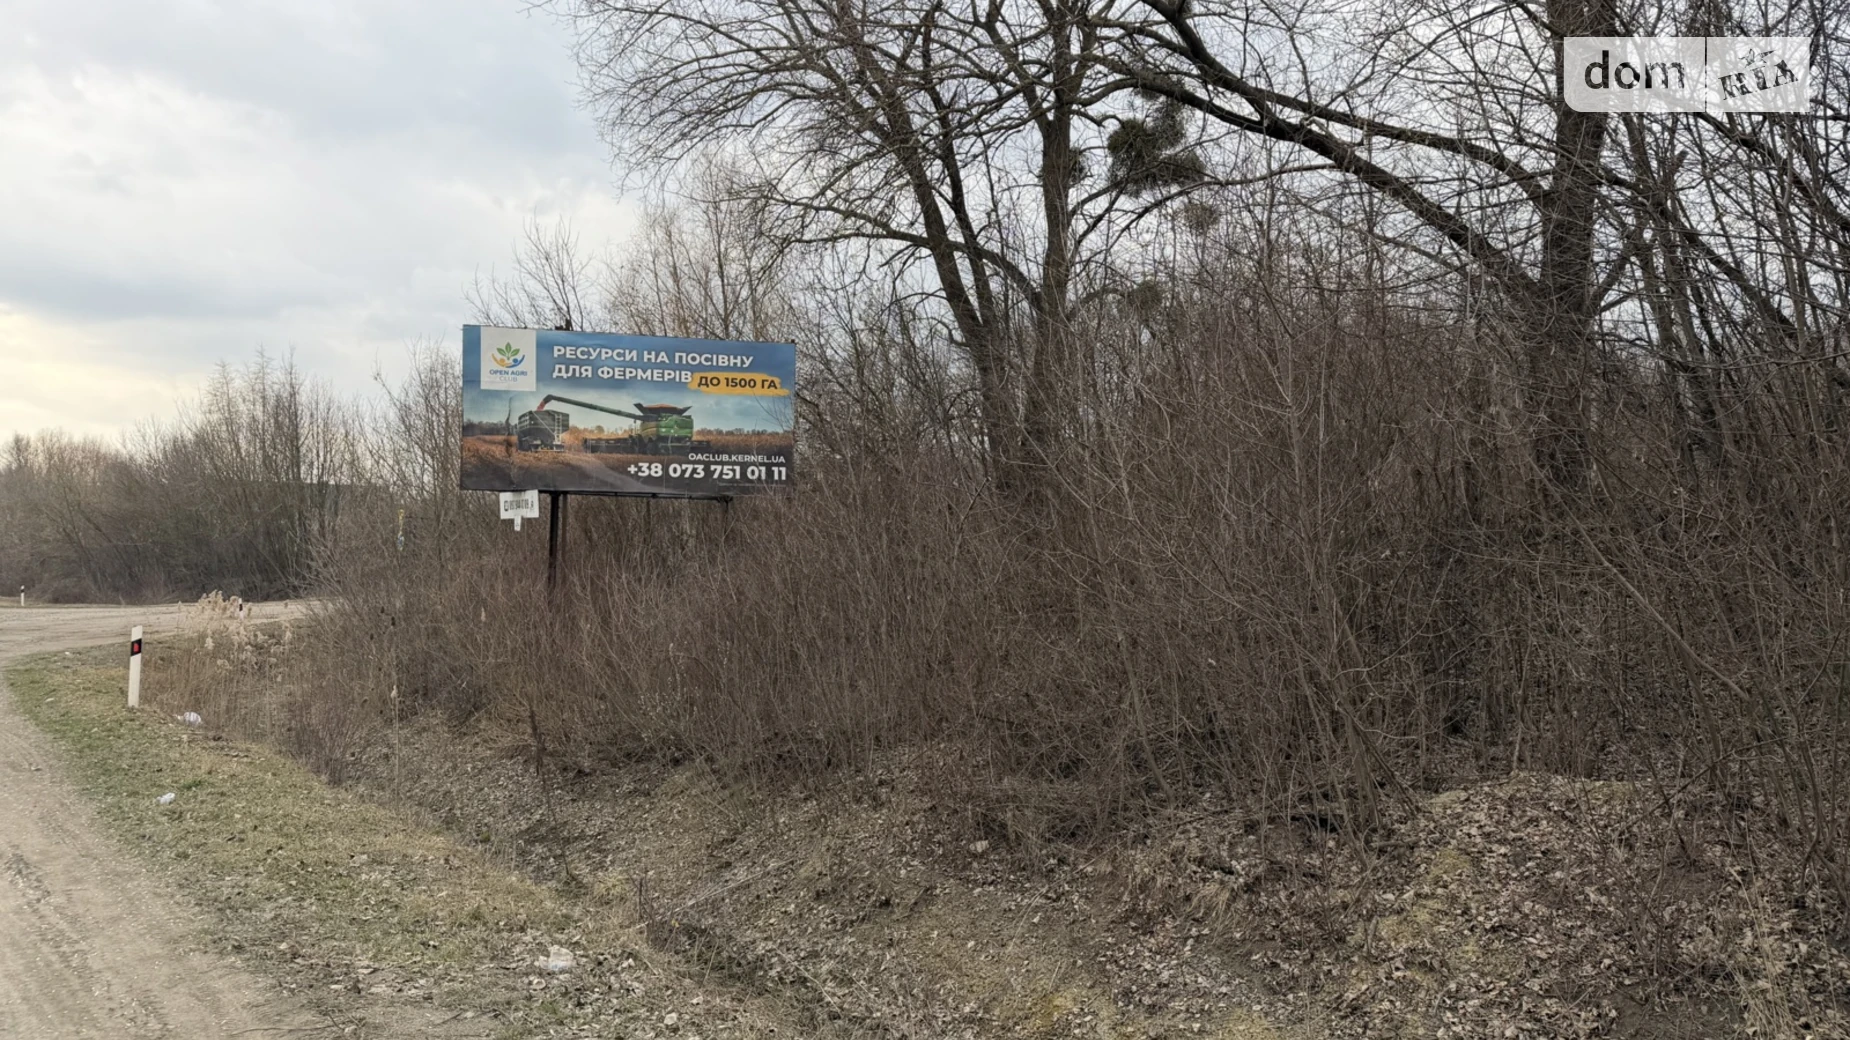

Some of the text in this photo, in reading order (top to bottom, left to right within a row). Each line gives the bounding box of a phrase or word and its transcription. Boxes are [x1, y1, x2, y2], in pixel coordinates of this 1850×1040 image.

[553, 345, 754, 368] РЕСУРСИ НА ПОСІВНУ
[552, 364, 693, 383] ДЛЯ ФЕРМЕРІВ
[697, 376, 778, 390] ДО 1500 ГА
[688, 452, 786, 464] OACLUB.KERNEL.UA
[627, 462, 787, 481] +38 073 751 01 11
